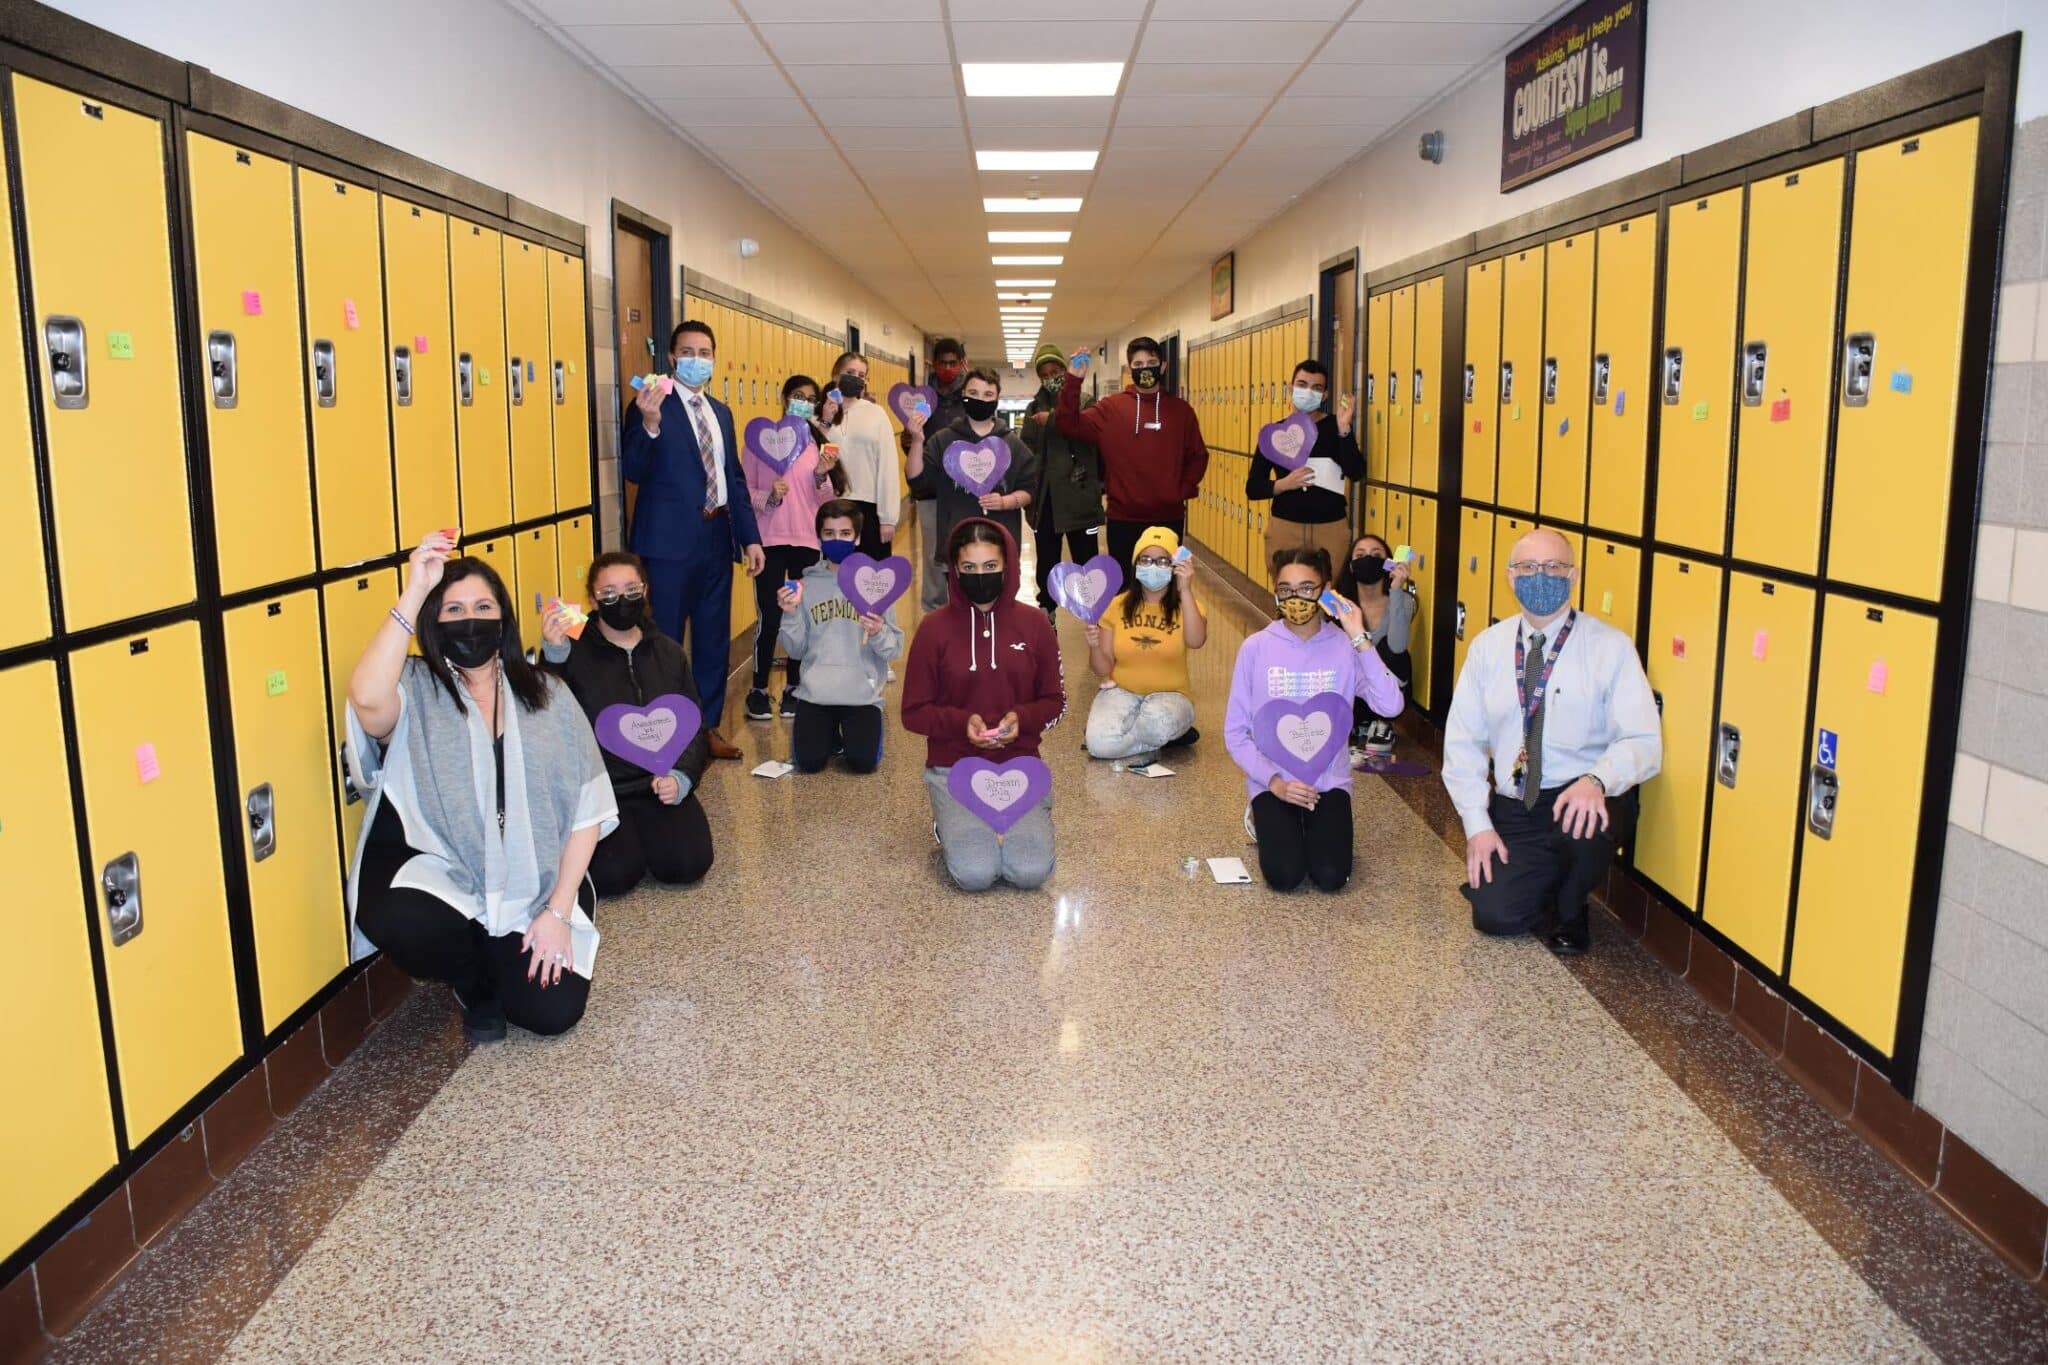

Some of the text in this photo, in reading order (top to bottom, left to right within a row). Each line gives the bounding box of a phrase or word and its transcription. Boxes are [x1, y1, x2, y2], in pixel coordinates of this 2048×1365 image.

[1566, 32, 1585, 54] May
[1592, 15, 1613, 38] help
[1614, 2, 1633, 28] you
[1513, 48, 1587, 140] COURTESY
[811, 598, 860, 625] VERMON
[984, 776, 1019, 791] Dream
